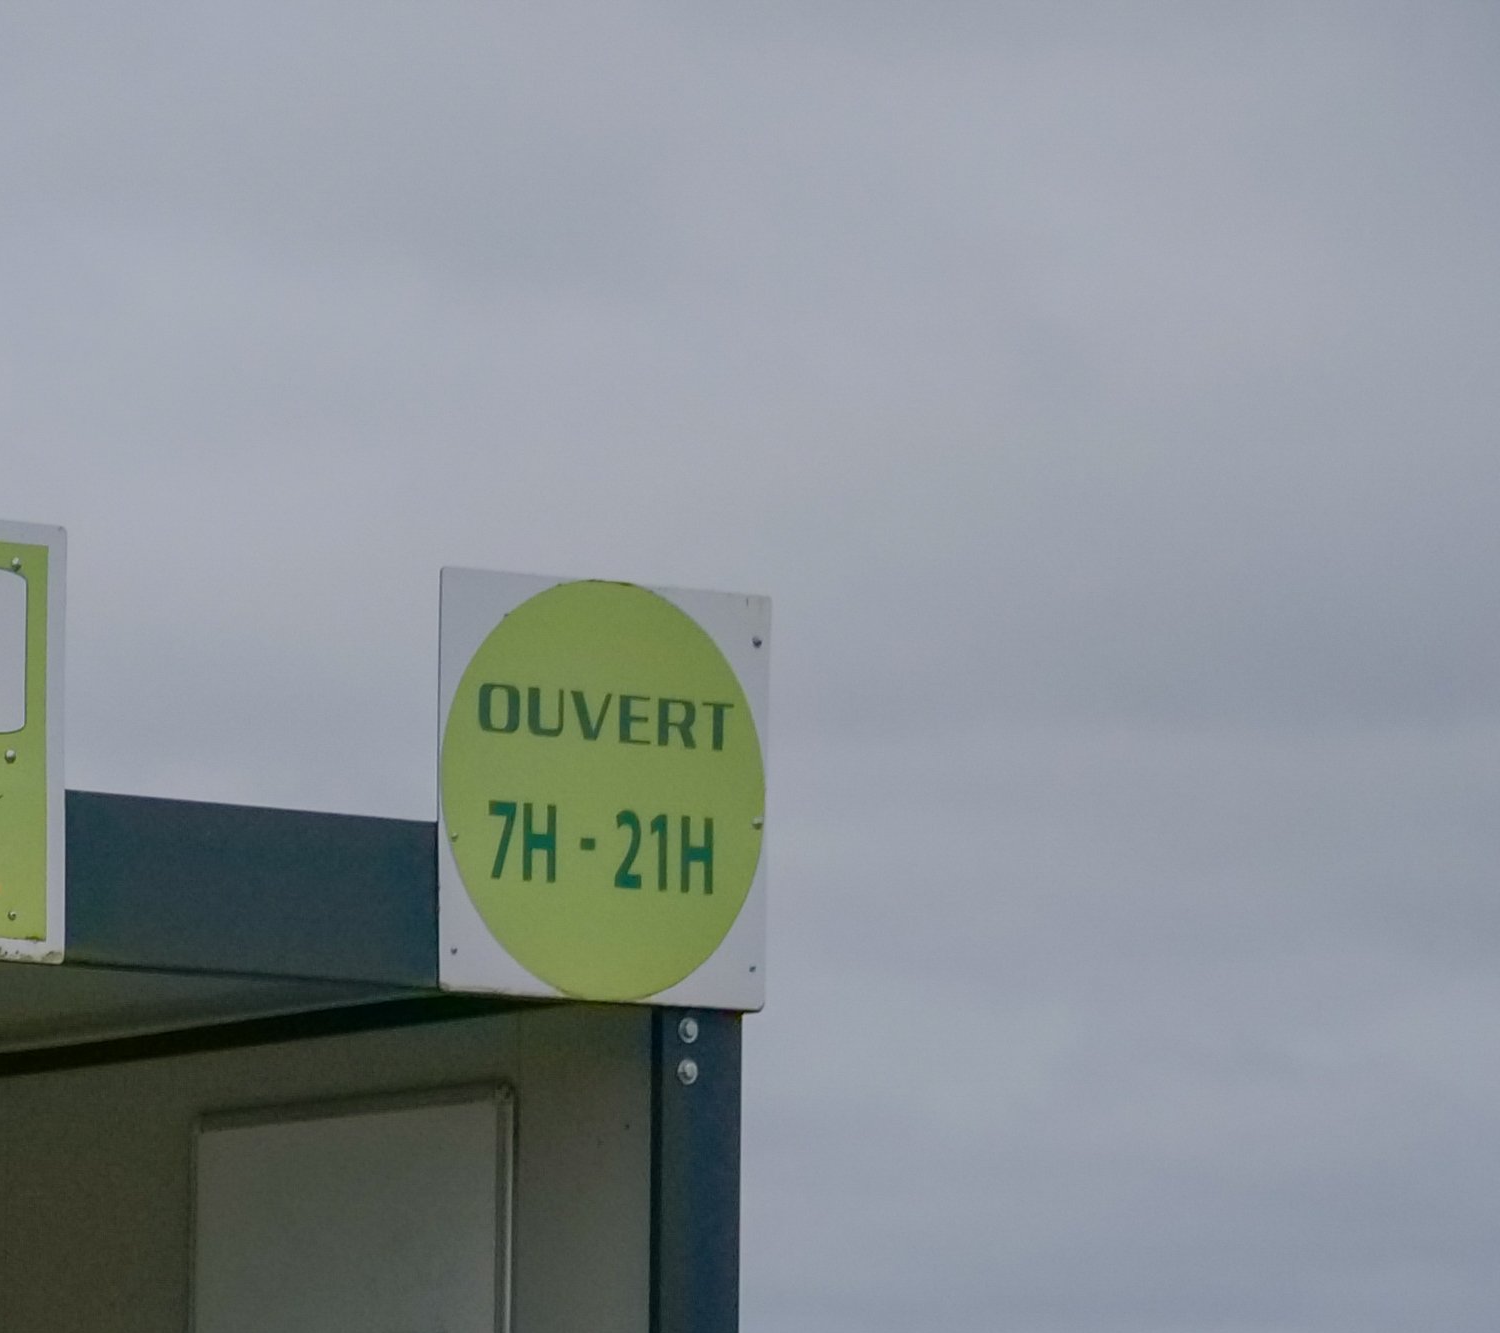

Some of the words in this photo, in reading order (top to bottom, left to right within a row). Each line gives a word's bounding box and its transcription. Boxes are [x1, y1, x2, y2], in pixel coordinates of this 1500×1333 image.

[477, 682, 735, 752] OUVERT
[487, 799, 558, 884] 7H
[579, 837, 597, 851] -
[614, 809, 715, 895] 21H
